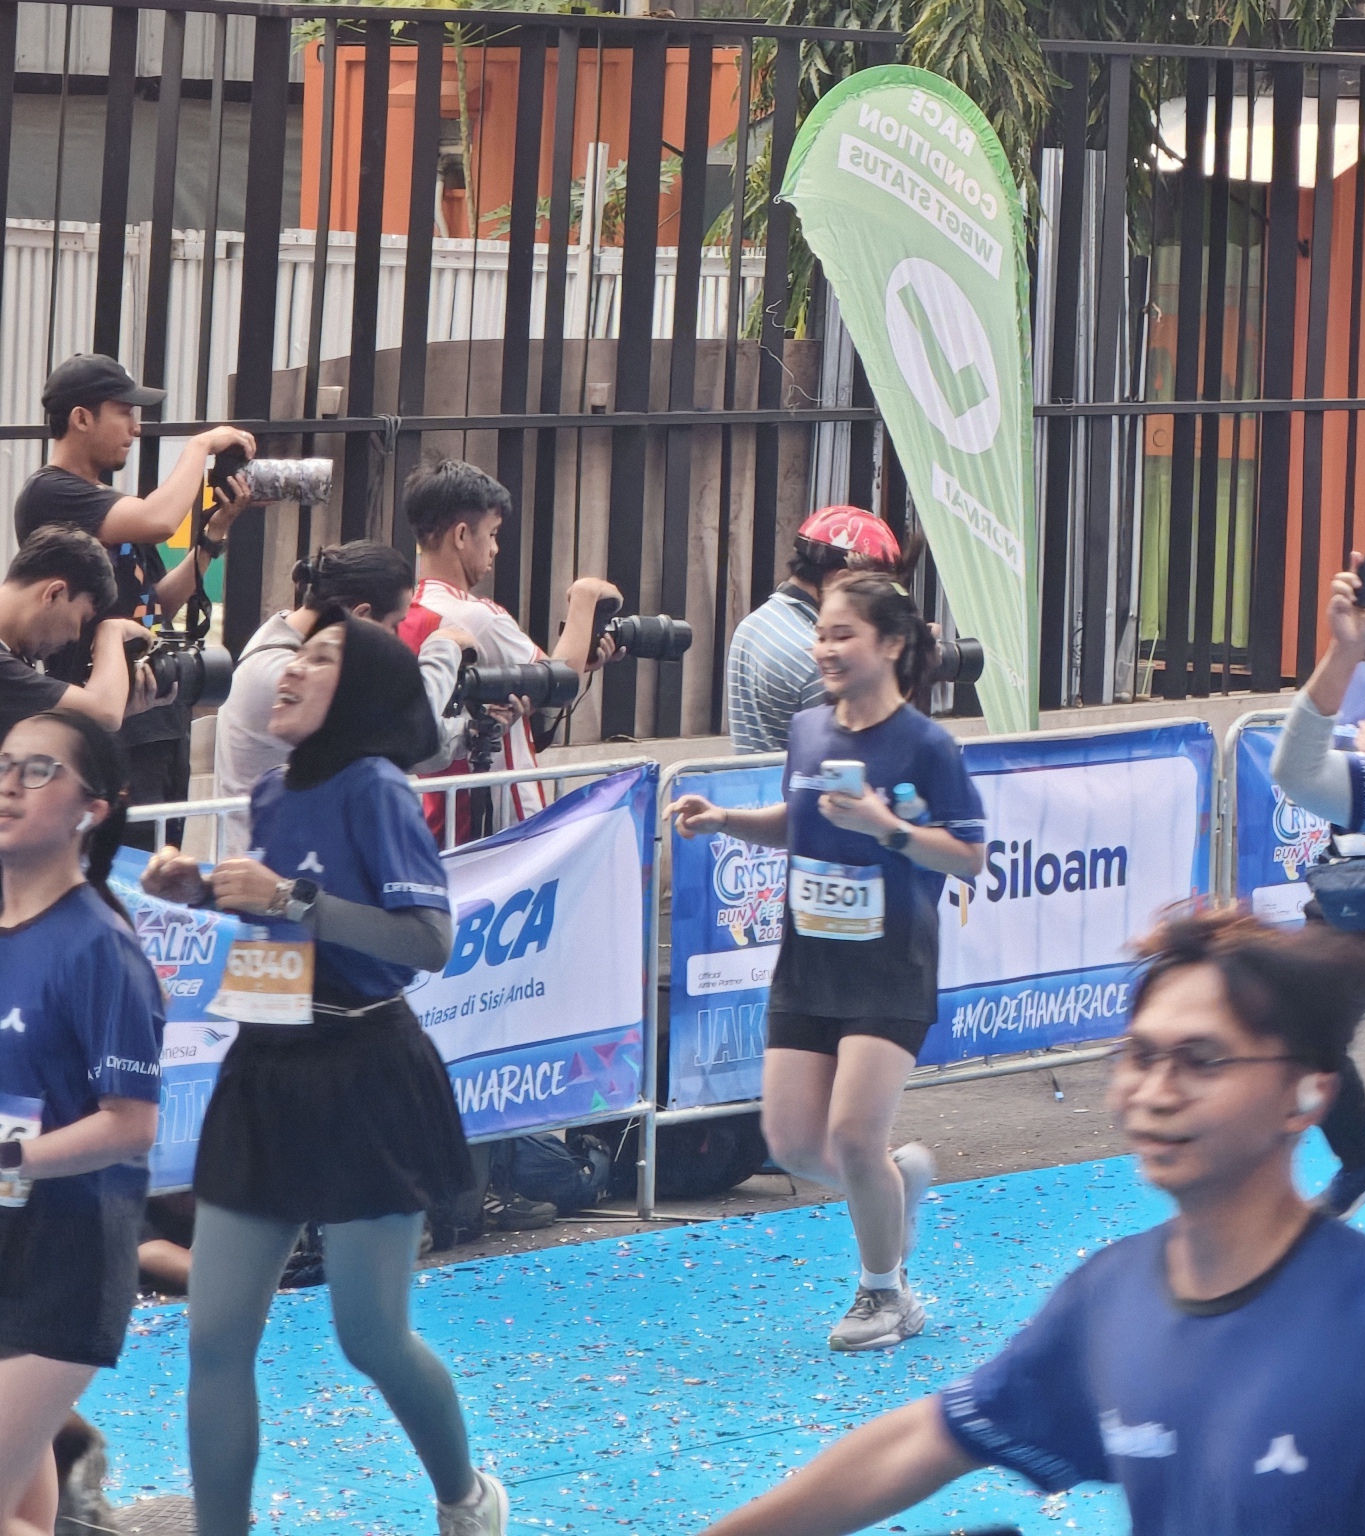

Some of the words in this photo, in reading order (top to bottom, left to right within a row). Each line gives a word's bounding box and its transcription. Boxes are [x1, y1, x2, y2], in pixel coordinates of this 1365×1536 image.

[801, 879, 869, 907] 51501
[986, 839, 1127, 902] Siloam
[442, 878, 559, 979] BCA
[757, 926, 782, 943] 202
[461, 996, 475, 1016] di
[479, 991, 504, 1012] Sisi
[505, 977, 546, 1004] Anda
[951, 983, 1130, 1042] #MORETHANARACE
